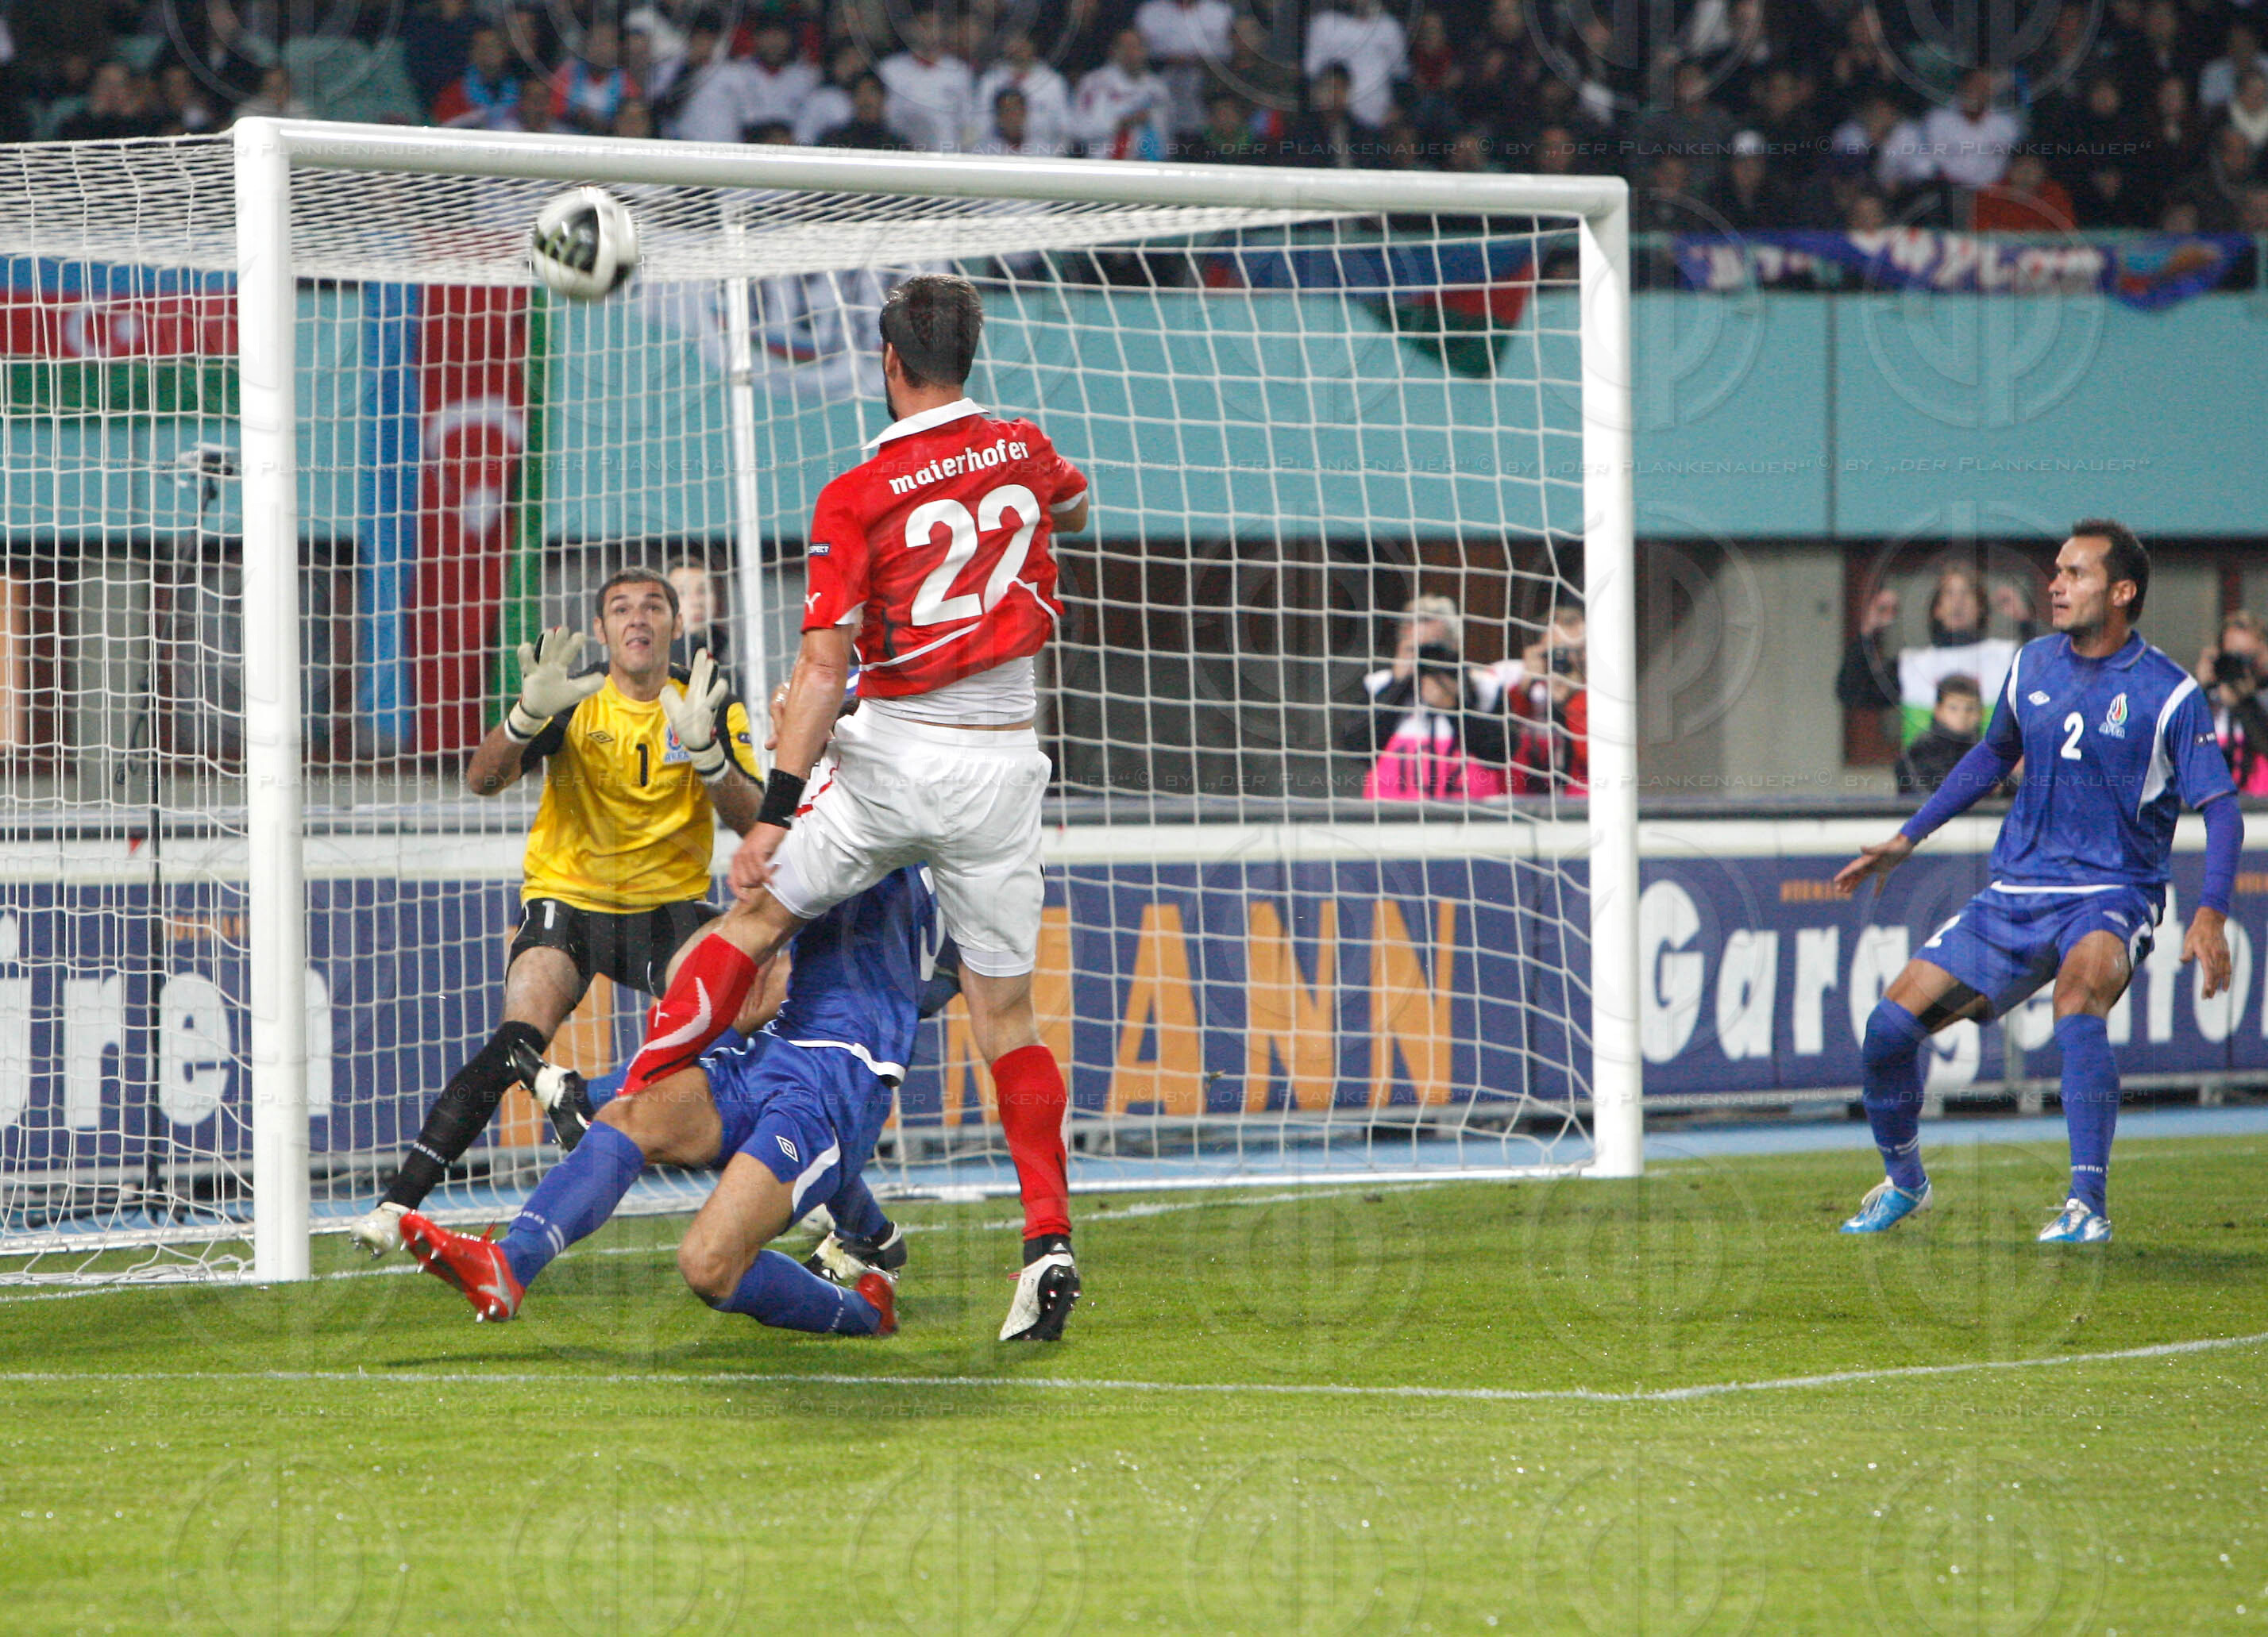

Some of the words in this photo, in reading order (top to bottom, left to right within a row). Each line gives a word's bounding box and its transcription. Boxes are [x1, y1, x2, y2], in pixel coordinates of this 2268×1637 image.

[889, 438, 1030, 495] maierhofer
[904, 483, 1042, 626] 22
[2061, 711, 2085, 761] 2
[636, 743, 648, 788] 1
[542, 899, 556, 930] 1
